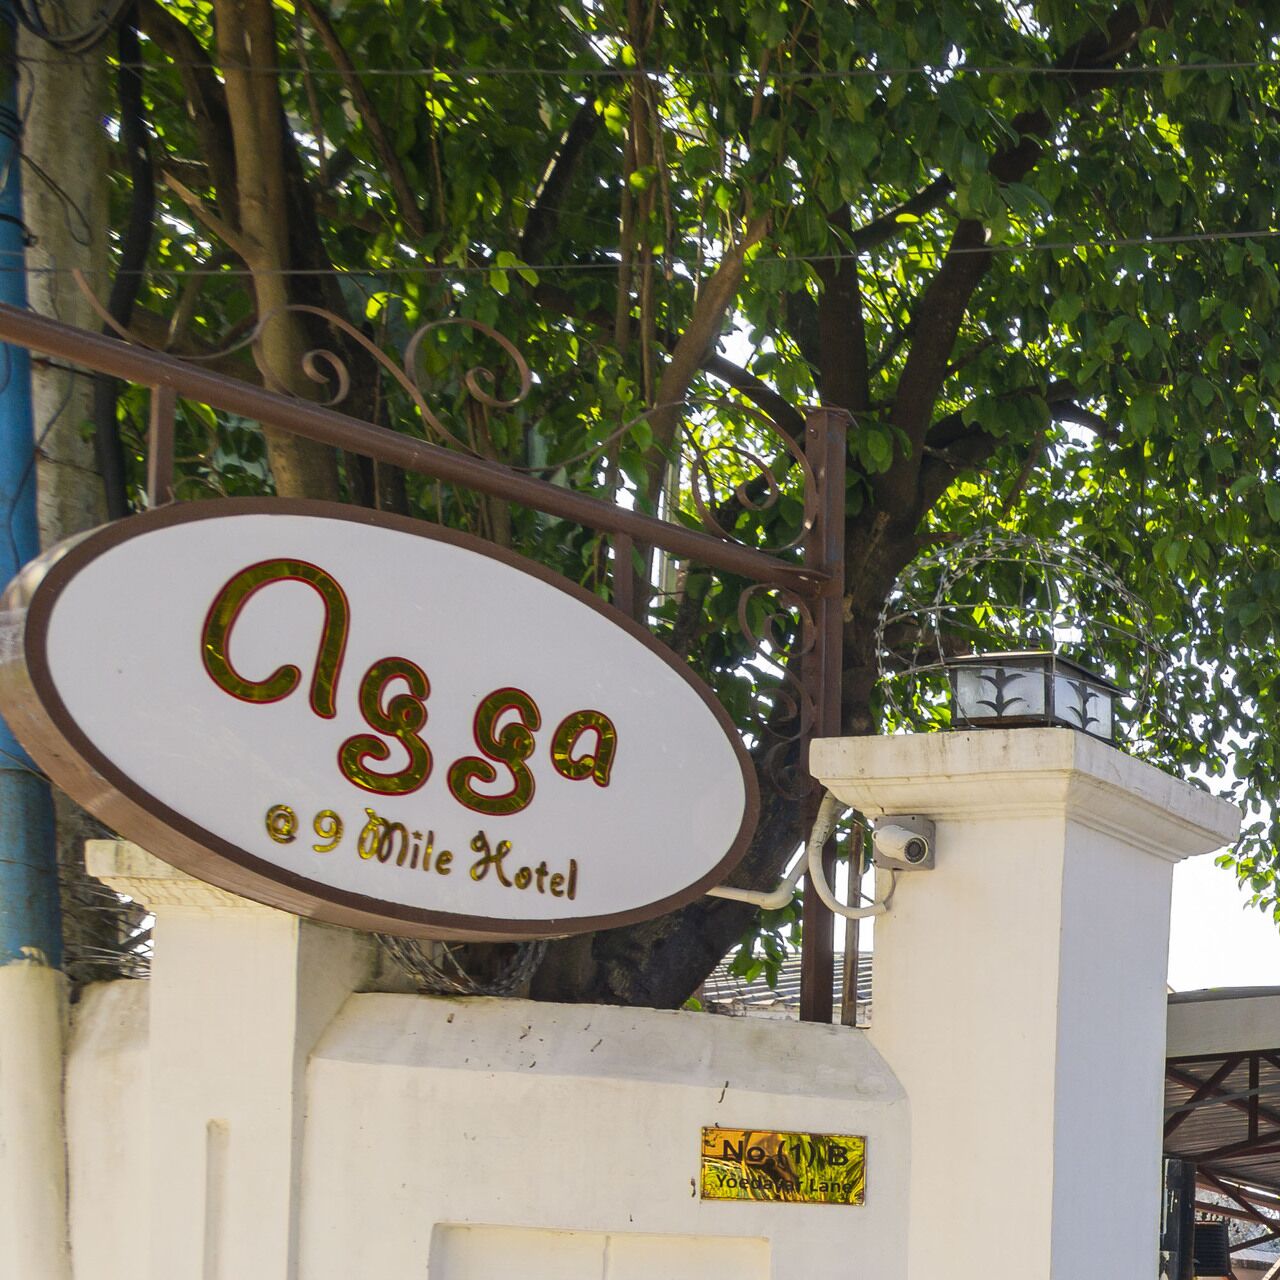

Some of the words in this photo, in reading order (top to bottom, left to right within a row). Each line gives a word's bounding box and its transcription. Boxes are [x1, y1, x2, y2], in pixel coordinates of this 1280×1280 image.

[200, 558, 618, 816] Agga
[312, 808, 344, 854] 9
[357, 807, 454, 876] Mile
[469, 830, 578, 901] Hotel
[810, 1178, 852, 1194] Lane
